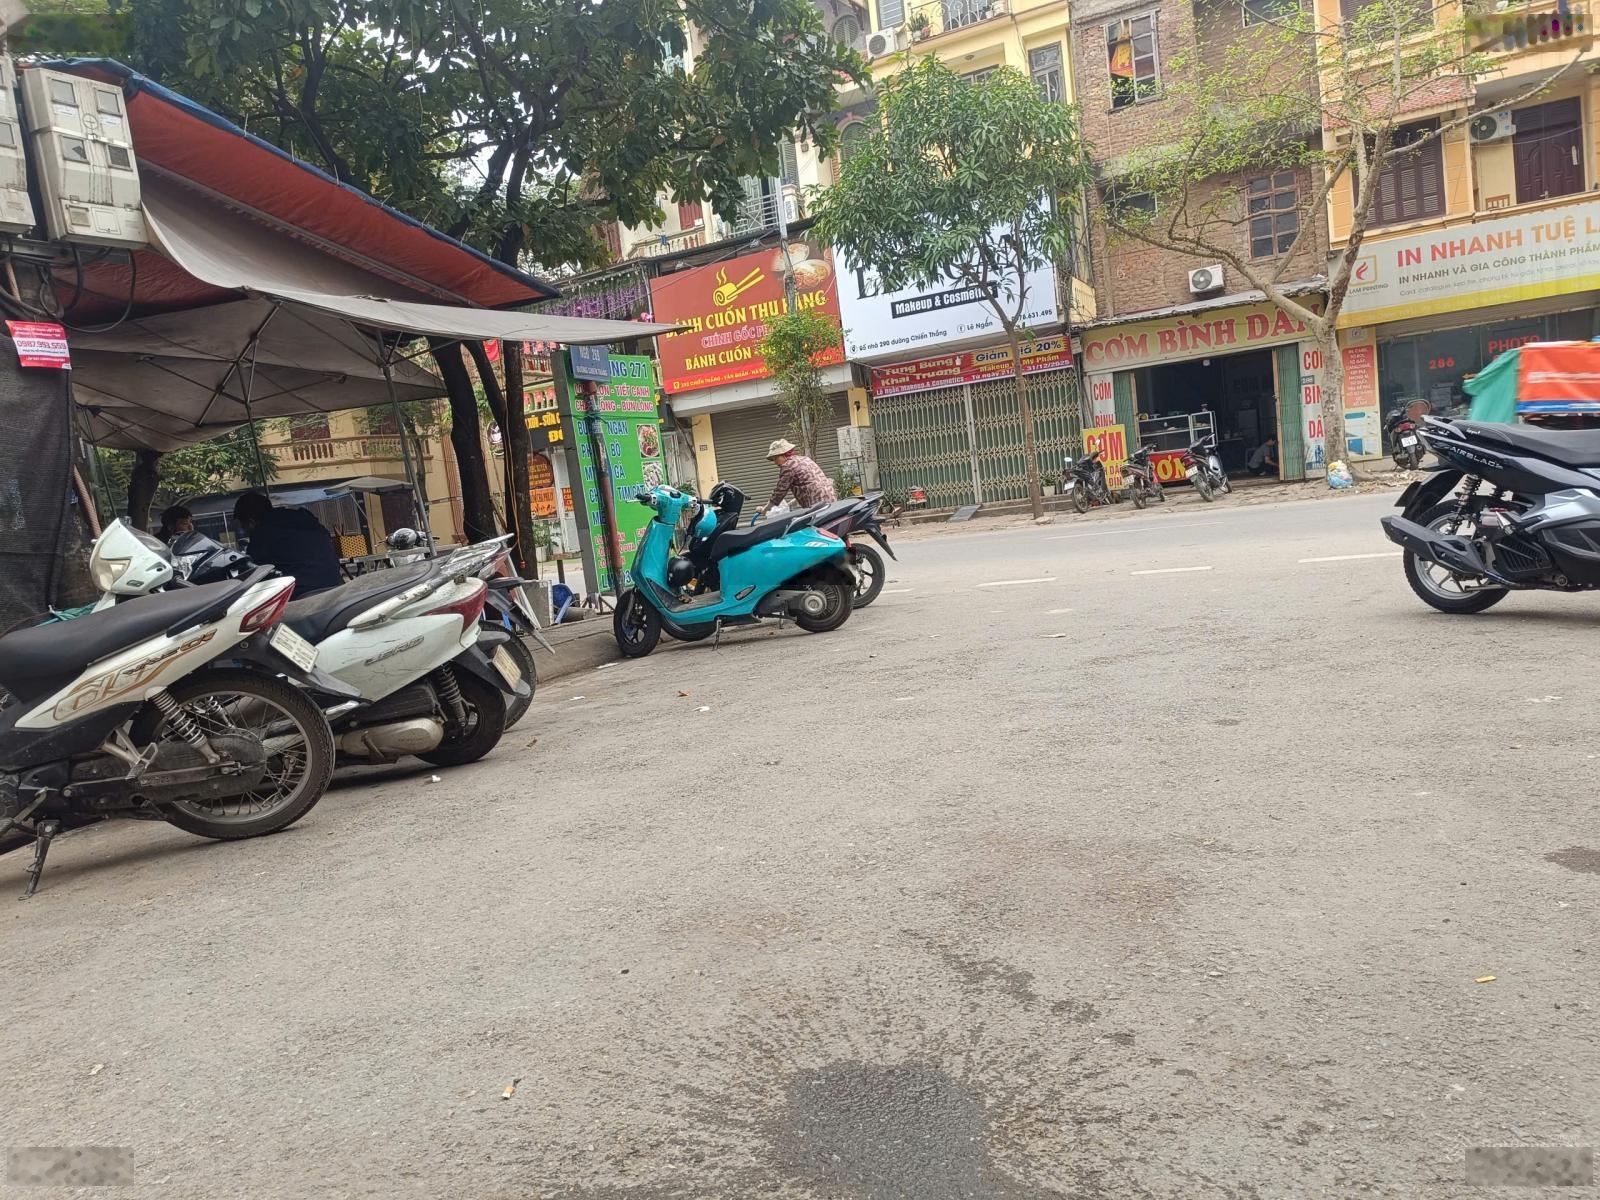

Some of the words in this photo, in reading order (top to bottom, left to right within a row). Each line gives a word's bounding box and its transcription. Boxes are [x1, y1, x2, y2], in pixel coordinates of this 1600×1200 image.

[1397, 247, 1422, 267] IN
[1430, 229, 1523, 261] NHANH
[1531, 214, 1576, 243] TUỆ
[1399, 276, 1409, 284] IN
[1412, 269, 1449, 283] NHANH
[1451, 264, 1468, 275] VÀ
[1470, 262, 1490, 273] GIA
[1492, 255, 1527, 269] CÔNG
[1529, 248, 1567, 262] THÀNH
[705, 305, 747, 330] CUỐN
[749, 300, 779, 321] THU
[895, 298, 933, 315] Makeup
[934, 295, 942, 307] &
[1036, 340, 1062, 352] 20%
[1085, 333, 1150, 364] CƠM
[1157, 318, 1237, 354] BÌNH
[630, 361, 648, 379] 271
[685, 353, 718, 371] BÁNH
[718, 345, 752, 364] CUỐN
[607, 421, 628, 436] NGAN
